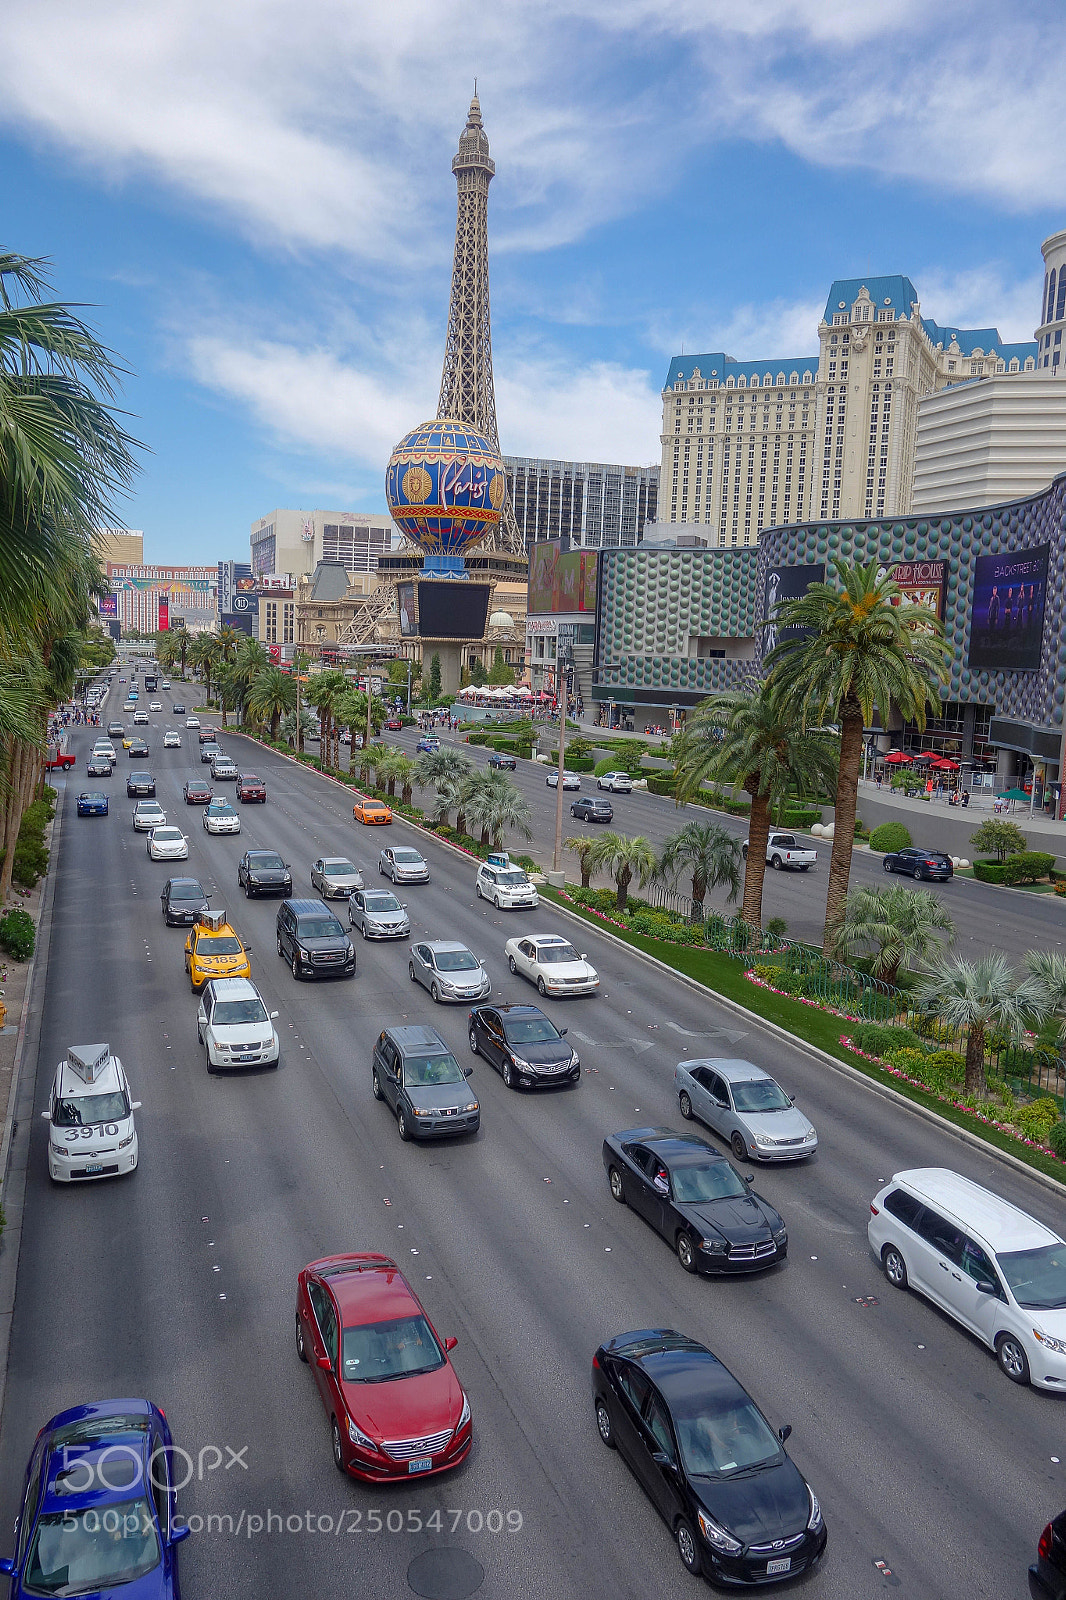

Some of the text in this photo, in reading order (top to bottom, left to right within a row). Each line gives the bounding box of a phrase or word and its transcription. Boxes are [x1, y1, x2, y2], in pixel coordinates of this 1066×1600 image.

[440, 454, 488, 511] Paris
[913, 563, 944, 582] HOUSE
[994, 561, 1033, 578] BACKSTREET
[203, 956, 238, 965] 3185
[64, 1123, 119, 1142] 3910
